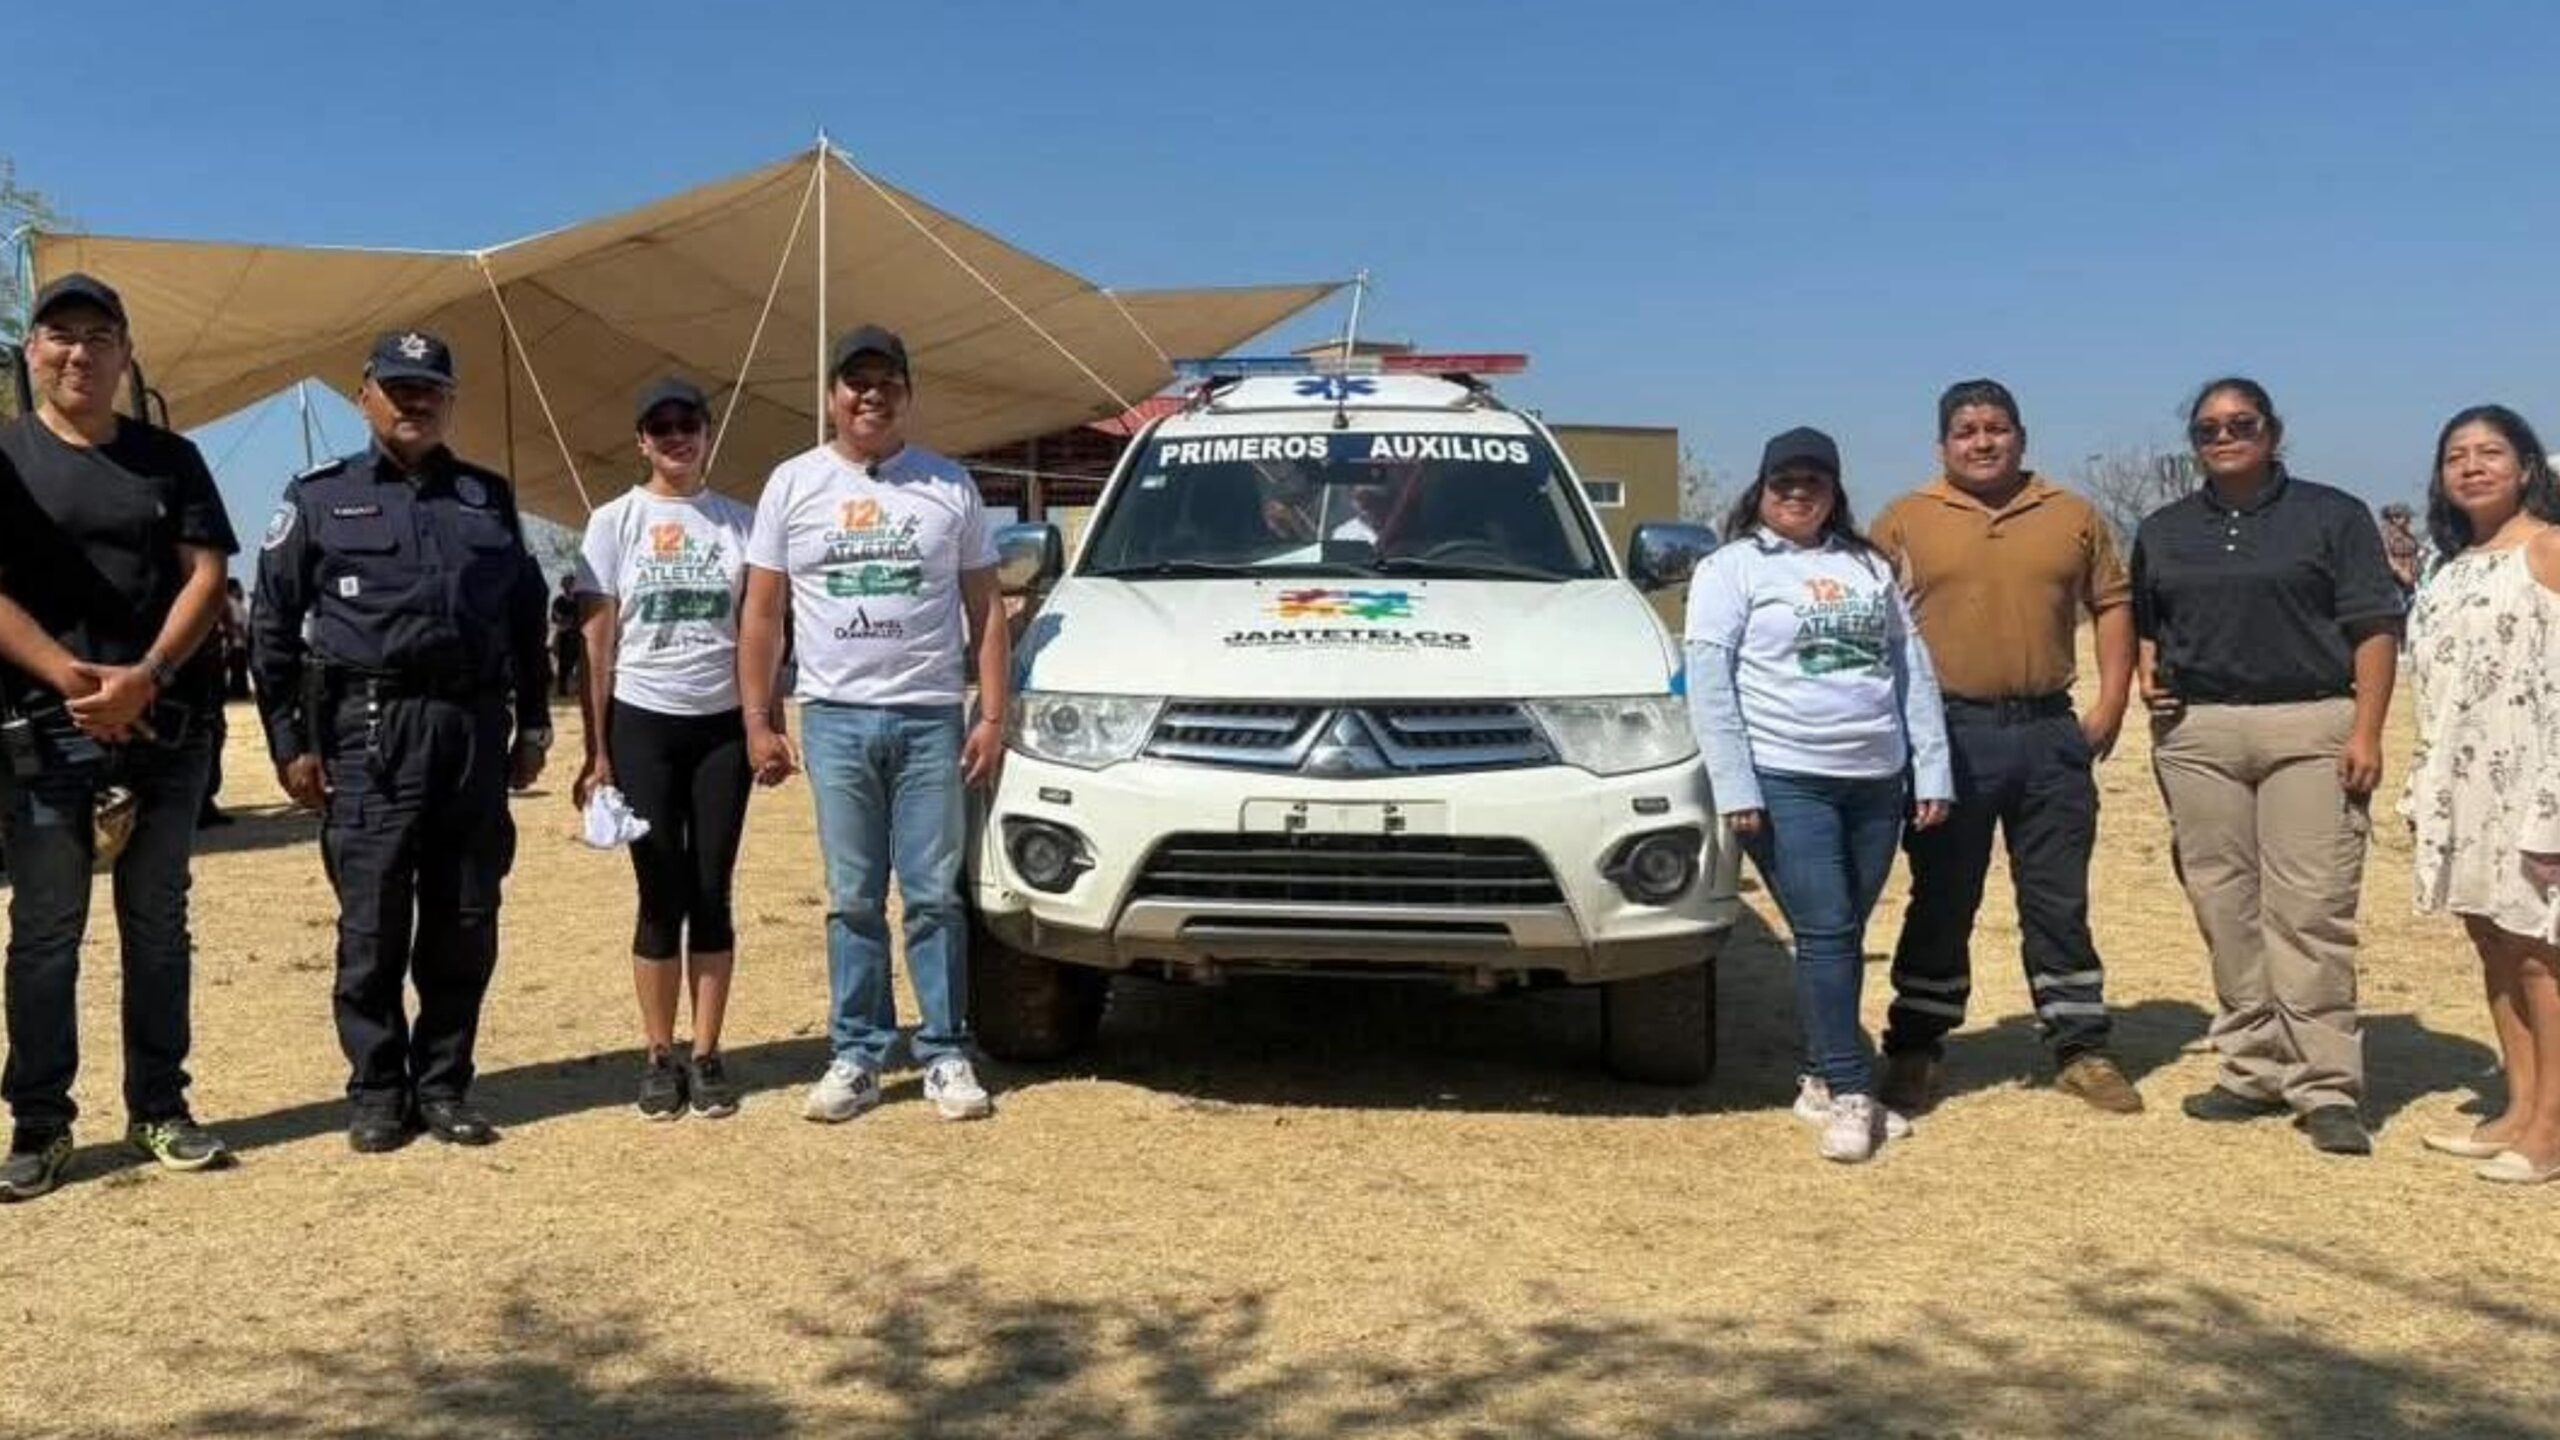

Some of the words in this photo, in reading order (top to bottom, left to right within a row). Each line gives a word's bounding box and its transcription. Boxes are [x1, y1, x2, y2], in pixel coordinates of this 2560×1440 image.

[1158, 436, 1329, 468] PRIMEROS
[1370, 435, 1530, 464] AUXILIOS
[1224, 628, 1472, 644] JANTETELCO
